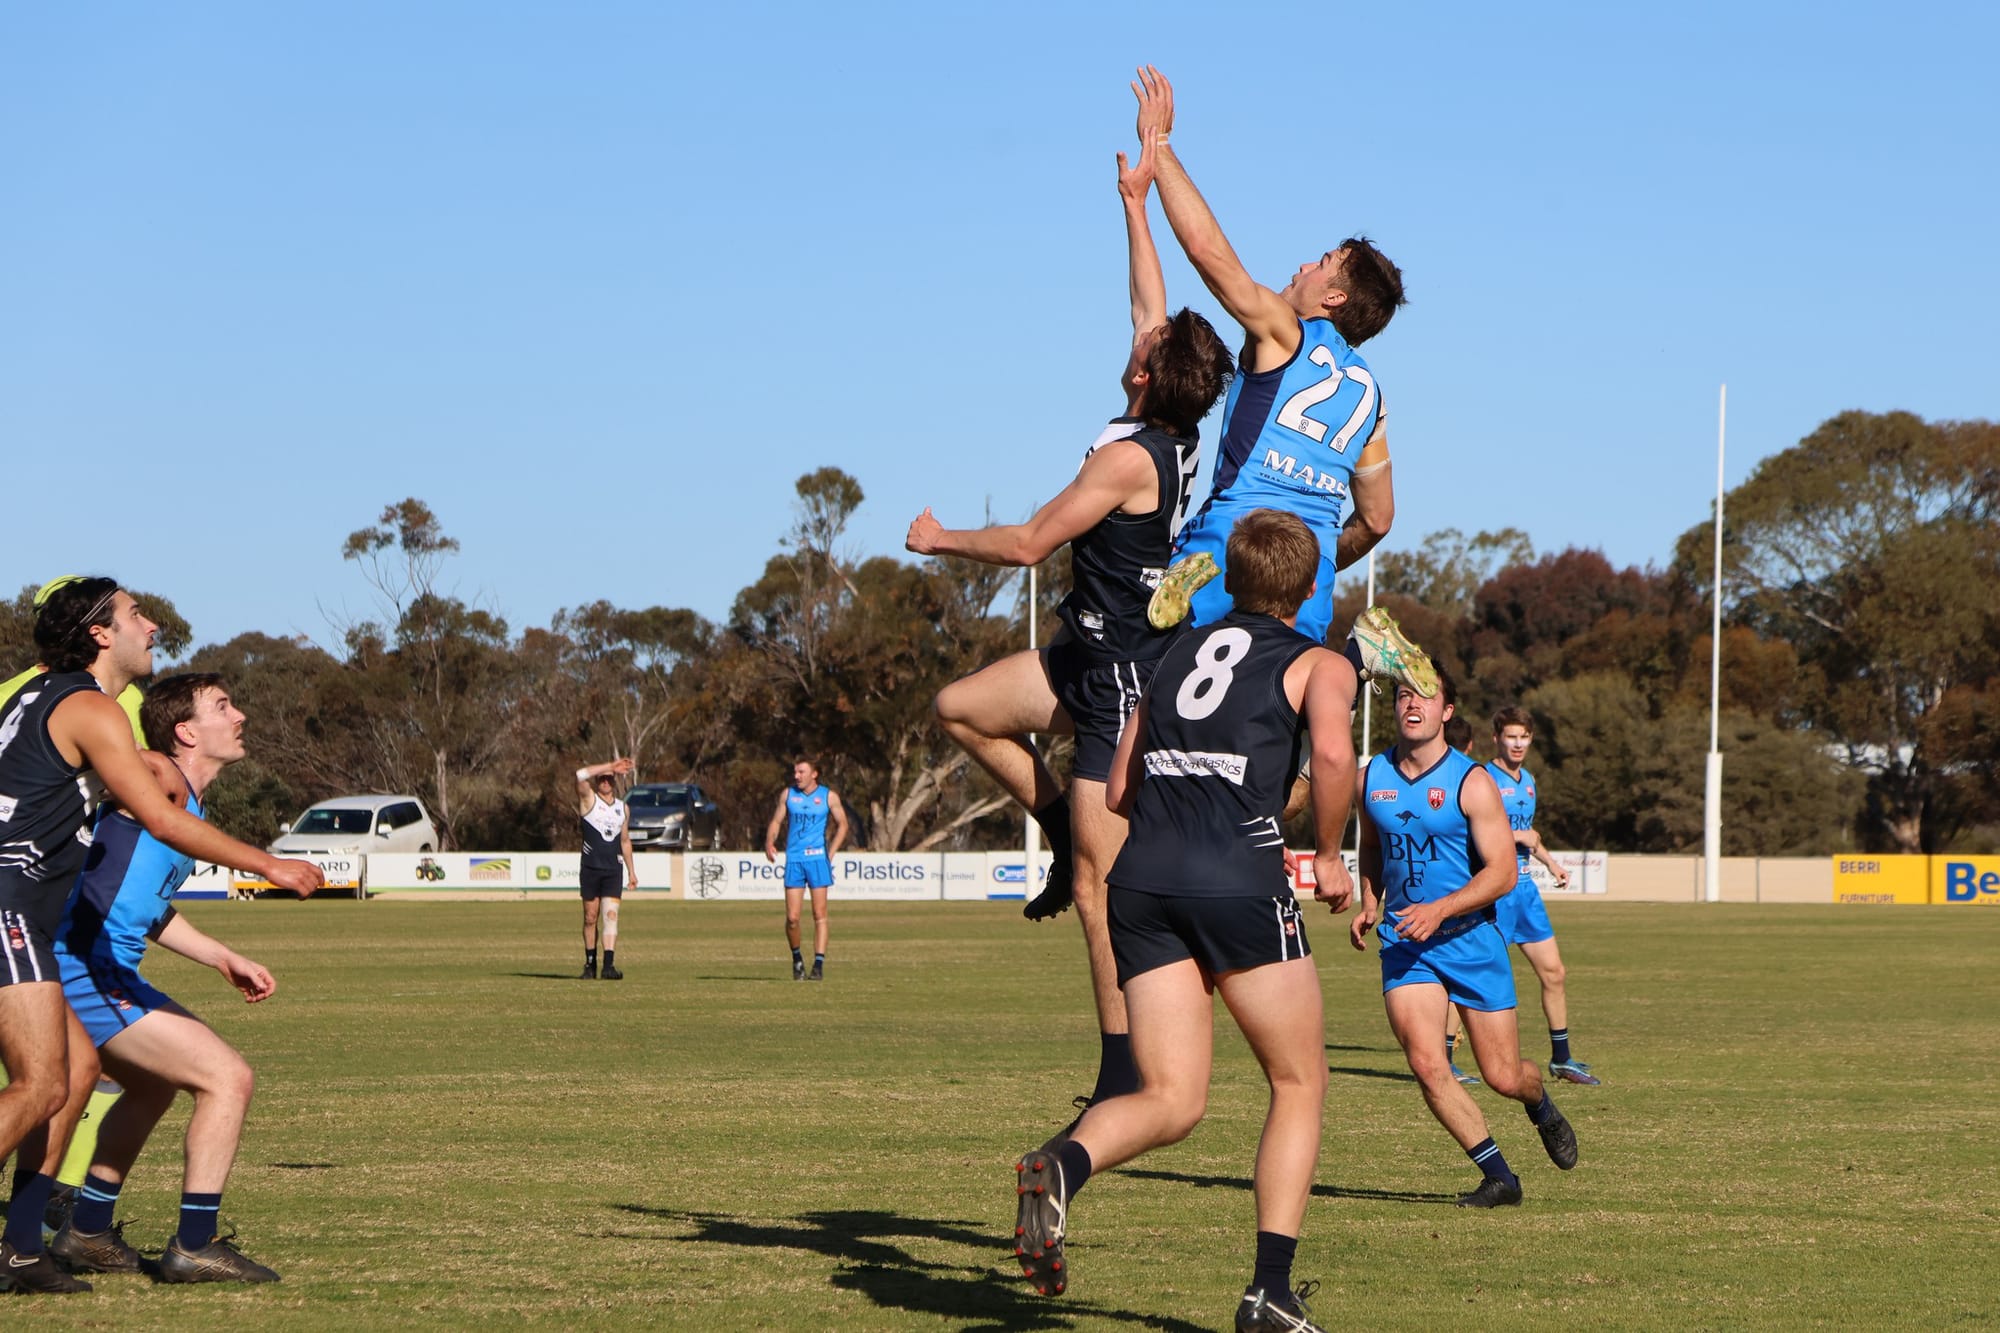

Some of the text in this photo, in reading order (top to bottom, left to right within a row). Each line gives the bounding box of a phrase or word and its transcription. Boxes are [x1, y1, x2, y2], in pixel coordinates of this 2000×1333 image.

[1276, 344, 1376, 455] 27
[1176, 627, 1253, 721] 8
[844, 860, 924, 881] Plastics
[1840, 861, 1880, 874] BERRI
[1840, 893, 1895, 903] FURNITURE
